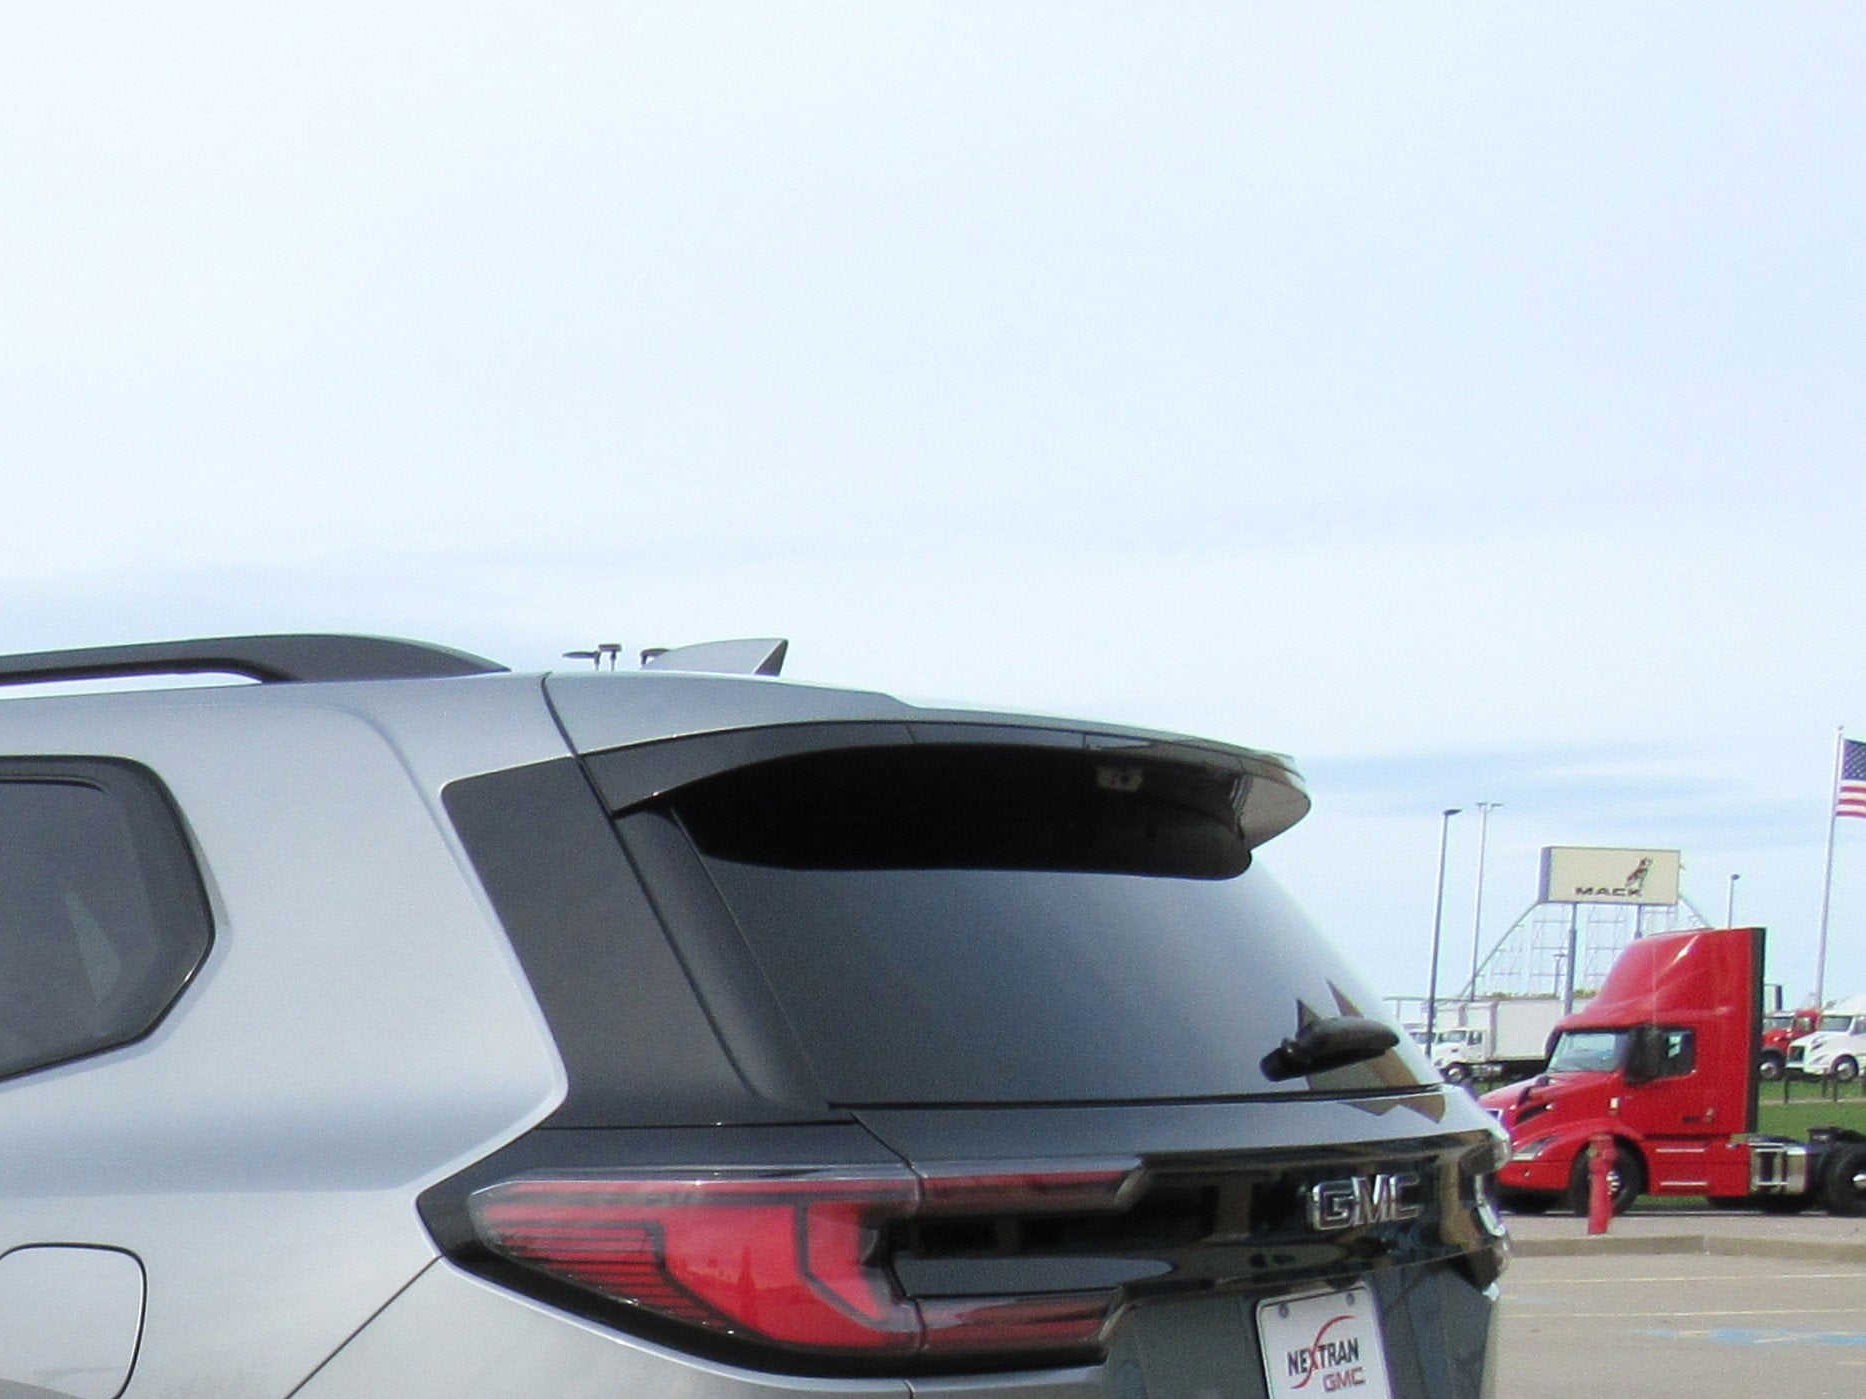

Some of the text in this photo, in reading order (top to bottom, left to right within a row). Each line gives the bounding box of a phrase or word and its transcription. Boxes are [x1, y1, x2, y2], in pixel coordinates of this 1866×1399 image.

[1575, 886, 1644, 898] MACK
[1312, 1173, 1420, 1231] GMC
[1287, 1337, 1360, 1377] NEXTRAN
[1323, 1367, 1366, 1392] GMC
